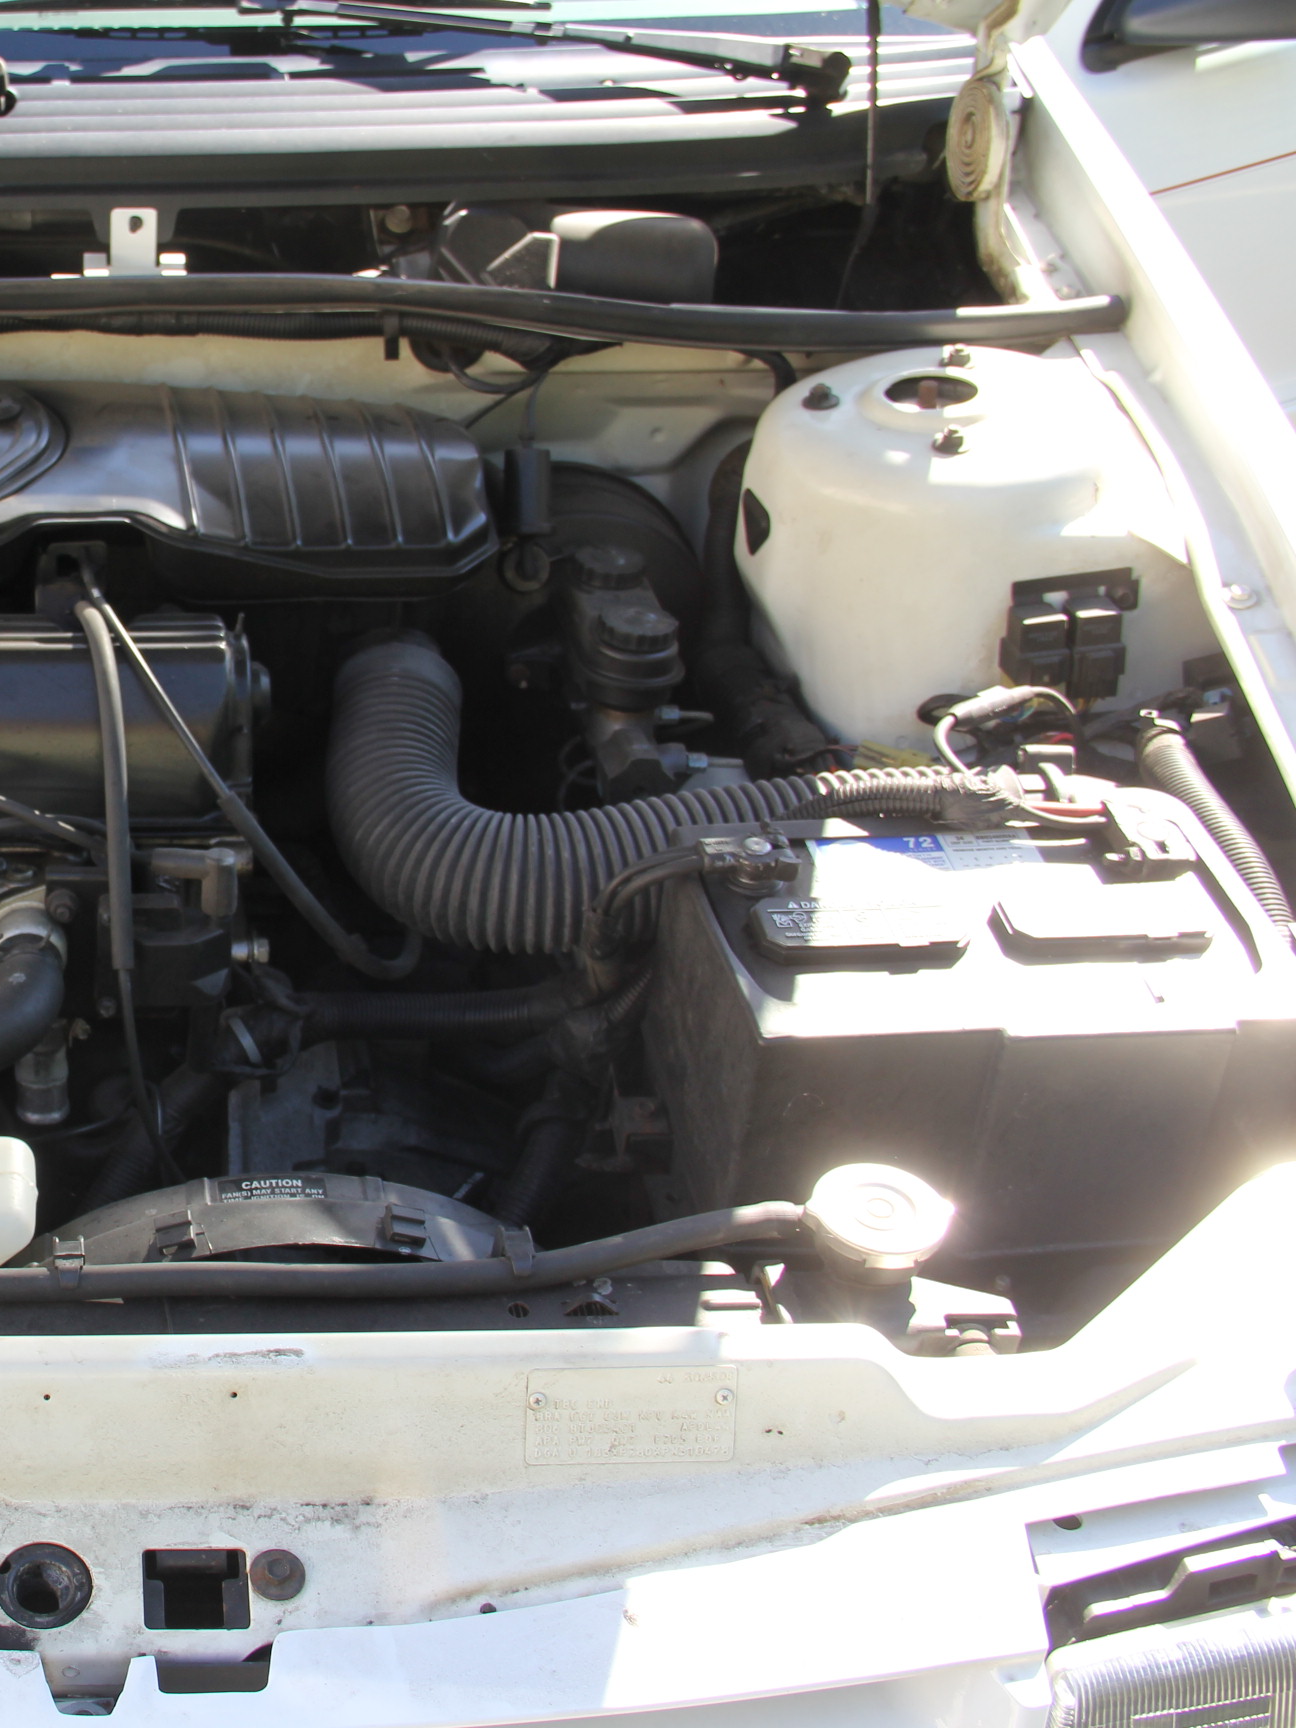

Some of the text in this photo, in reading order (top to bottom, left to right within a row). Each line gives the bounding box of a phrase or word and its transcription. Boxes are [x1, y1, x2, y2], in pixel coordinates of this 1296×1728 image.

[903, 837, 934, 848] 72
[241, 1179, 302, 1190] CAUTION
[221, 1190, 251, 1199] FAN(S)
[252, 1188, 272, 1196] MAY
